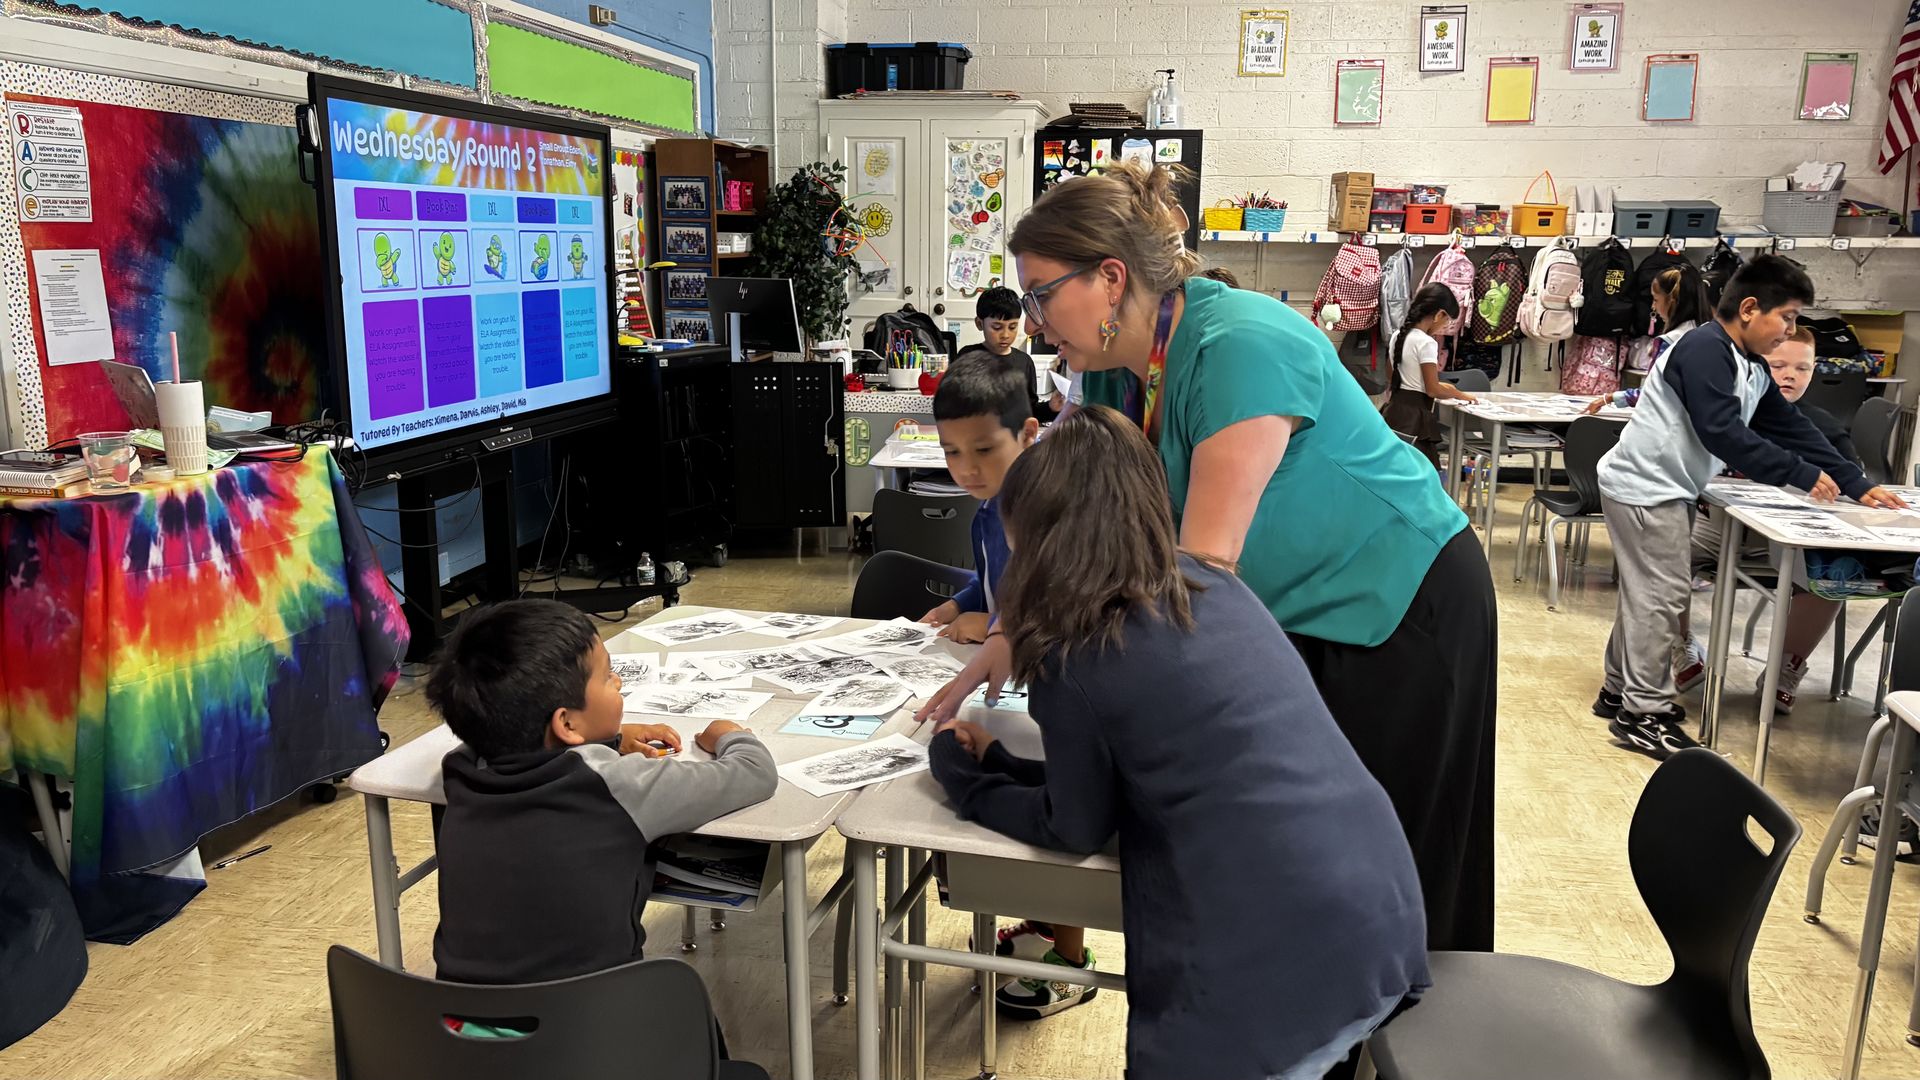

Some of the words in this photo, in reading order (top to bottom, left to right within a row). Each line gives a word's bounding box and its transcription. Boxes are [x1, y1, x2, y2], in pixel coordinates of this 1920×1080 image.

[1427, 42, 1455, 50] AWESOME
[1580, 40, 1608, 48] AMAZING
[1432, 51, 1449, 59] WORK
[1584, 49, 1603, 57] WORK
[16, 114, 30, 135] R
[21, 141, 33, 161] A
[333, 121, 460, 171] Wednesday
[465, 138, 520, 170] Round
[527, 147, 536, 172] 2
[539, 142, 553, 151] Small
[541, 157, 565, 167] onathan,
[22, 169, 33, 190] C
[378, 196, 391, 213] IXL
[488, 201, 498, 216] IXL
[739, 281, 748, 299] hp
[360, 428, 390, 443] Tutored
[392, 425, 401, 437] By
[401, 419, 433, 434] Teachers:
[434, 414, 459, 427] Ximena,
[480, 402, 500, 416] Ashley,
[501, 399, 517, 411] David,
[518, 397, 527, 407] Mia
[845, 417, 871, 466] C
